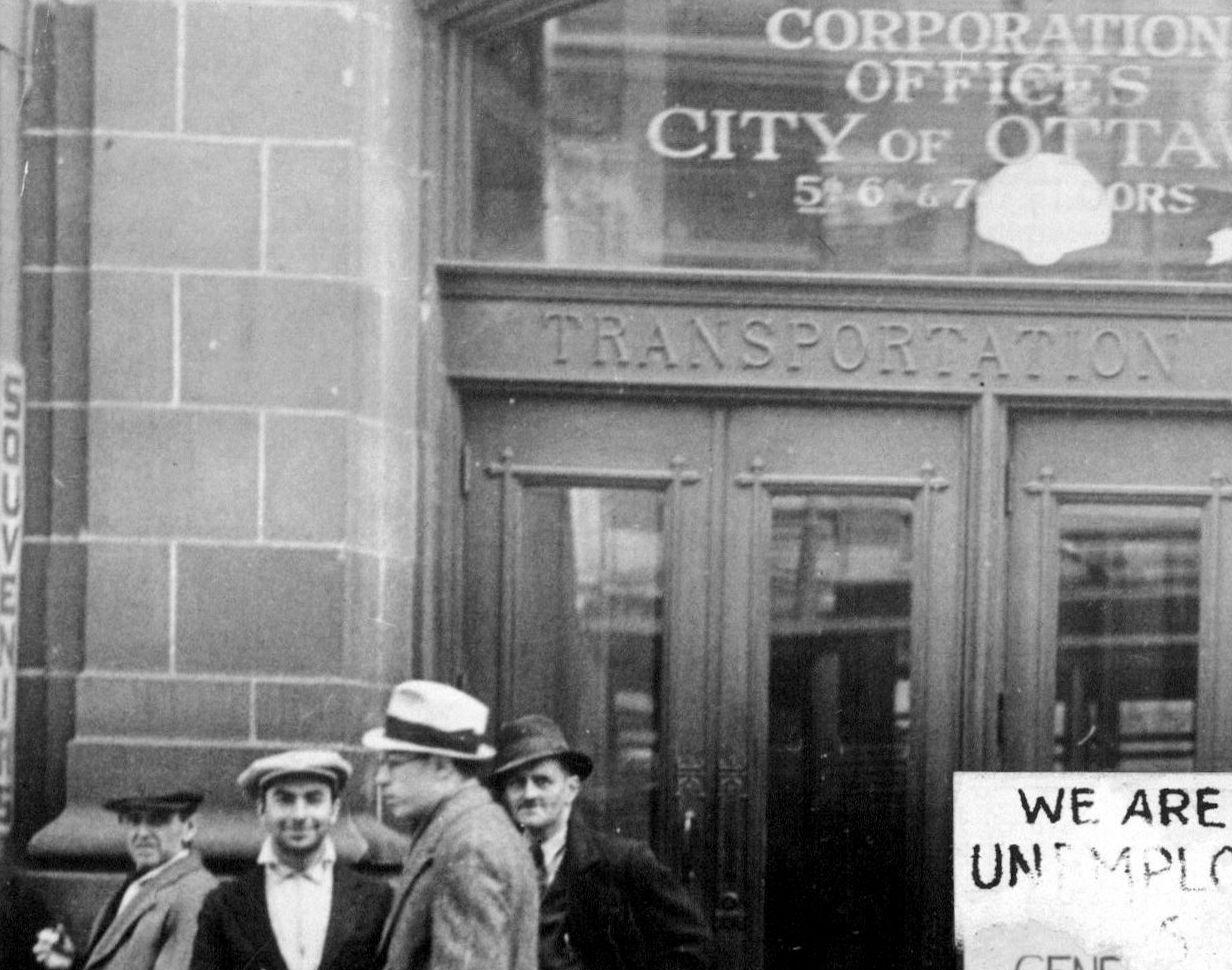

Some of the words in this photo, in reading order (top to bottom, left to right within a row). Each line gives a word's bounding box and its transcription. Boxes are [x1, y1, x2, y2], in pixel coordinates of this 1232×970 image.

[765, 7, 1232, 58] CORPORATION
[845, 60, 1152, 107] OFFICES
[647, 107, 868, 162] CITY
[878, 129, 952, 164] OF
[543, 313, 1178, 382] TRANSPORTATION
[1018, 786, 1099, 825] WE
[1122, 787, 1226, 829] ARE
